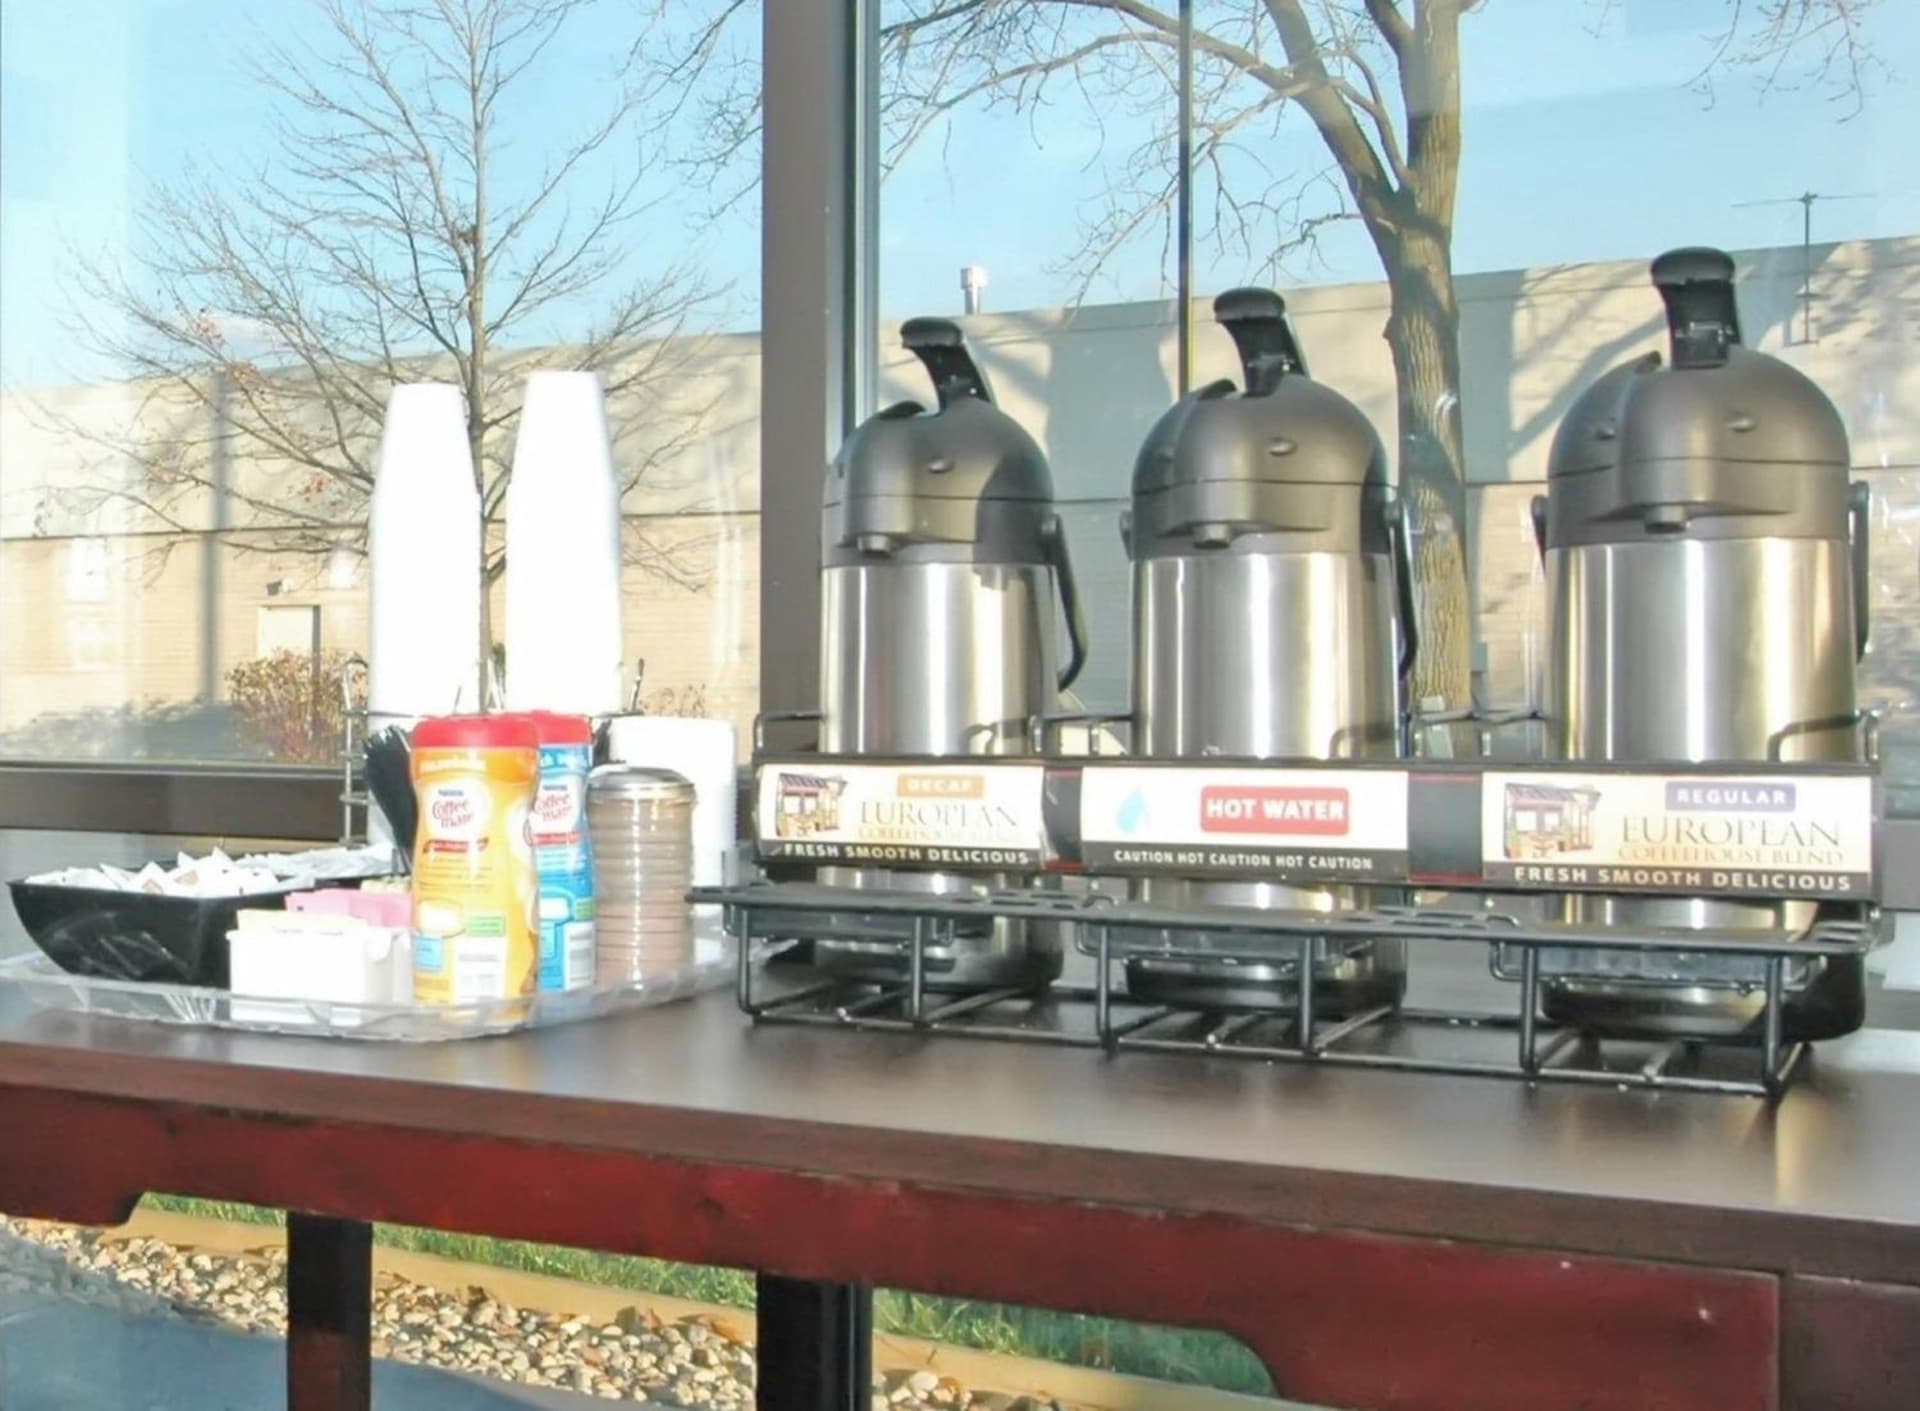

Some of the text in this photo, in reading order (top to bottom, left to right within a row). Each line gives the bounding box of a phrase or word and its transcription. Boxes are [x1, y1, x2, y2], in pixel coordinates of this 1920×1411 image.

[1676, 788, 1787, 806] REGULAR
[1207, 798, 1345, 821] HOT WATER
[1622, 815, 1841, 847] EUROPEAN
[784, 842, 1030, 865] FRESH SMOOTH DELICIOUS
[1113, 850, 1174, 864] CAUTION
[1209, 853, 1272, 867] CAUTION
[1308, 856, 1374, 870] CAUTION
[1514, 866, 1851, 890] FRESH SMOOTH DELICIOUS
